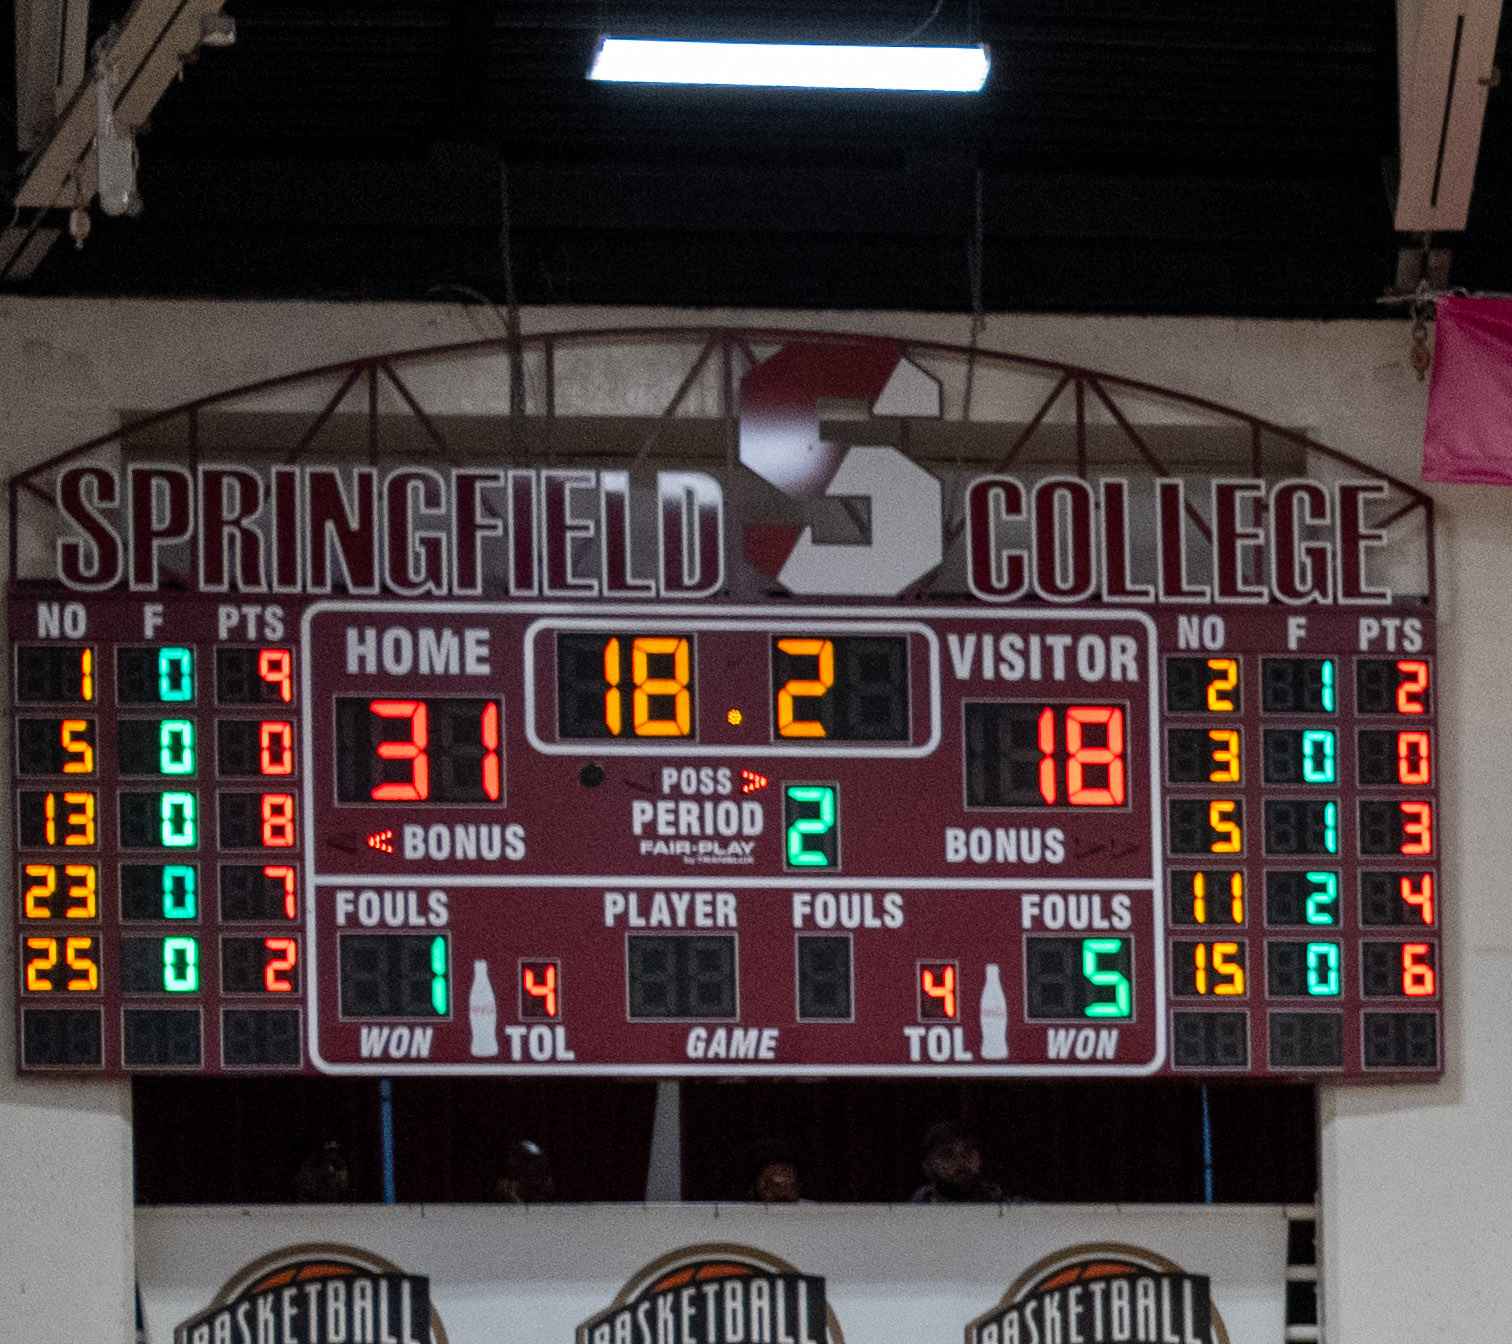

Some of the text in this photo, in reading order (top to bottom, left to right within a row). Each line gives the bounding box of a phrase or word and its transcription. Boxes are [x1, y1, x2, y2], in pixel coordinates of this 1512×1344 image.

[56, 463, 1393, 605] SPRINGFIELD COLLEGE
[37, 603, 285, 641] NO F PTS
[1178, 615, 1424, 653] NO F PTS
[81, 647, 292, 703] 1 0 9
[346, 627, 1139, 683] HOME VISITOR
[1206, 659, 1429, 714] 2 1 2
[61, 719, 294, 776] 5 0 0
[369, 699, 1125, 806] 31 18
[1209, 728, 1431, 785] 3 0 0
[661, 766, 733, 796] POSS
[46, 792, 296, 849] 13 0 8
[404, 823, 527, 863] BONUS
[631, 799, 764, 837] PERIOD
[786, 786, 836, 866] 2
[944, 826, 1065, 864] BONUS
[1210, 800, 1432, 856] 5 1 3
[25, 863, 297, 921] 23 0 7
[335, 891, 1132, 930] FOULS PLAYER FOULS FOULS
[1193, 871, 1435, 926] 11 2 4
[26, 936, 298, 993] 25 0 2
[429, 935, 448, 1016] 1
[522, 964, 558, 1018] 4
[920, 965, 957, 1018] 4
[1082, 938, 1131, 1018] 5
[1194, 942, 1436, 997] 15 0 6
[359, 1026, 1119, 1062] WON TOL GAME TOL WON
